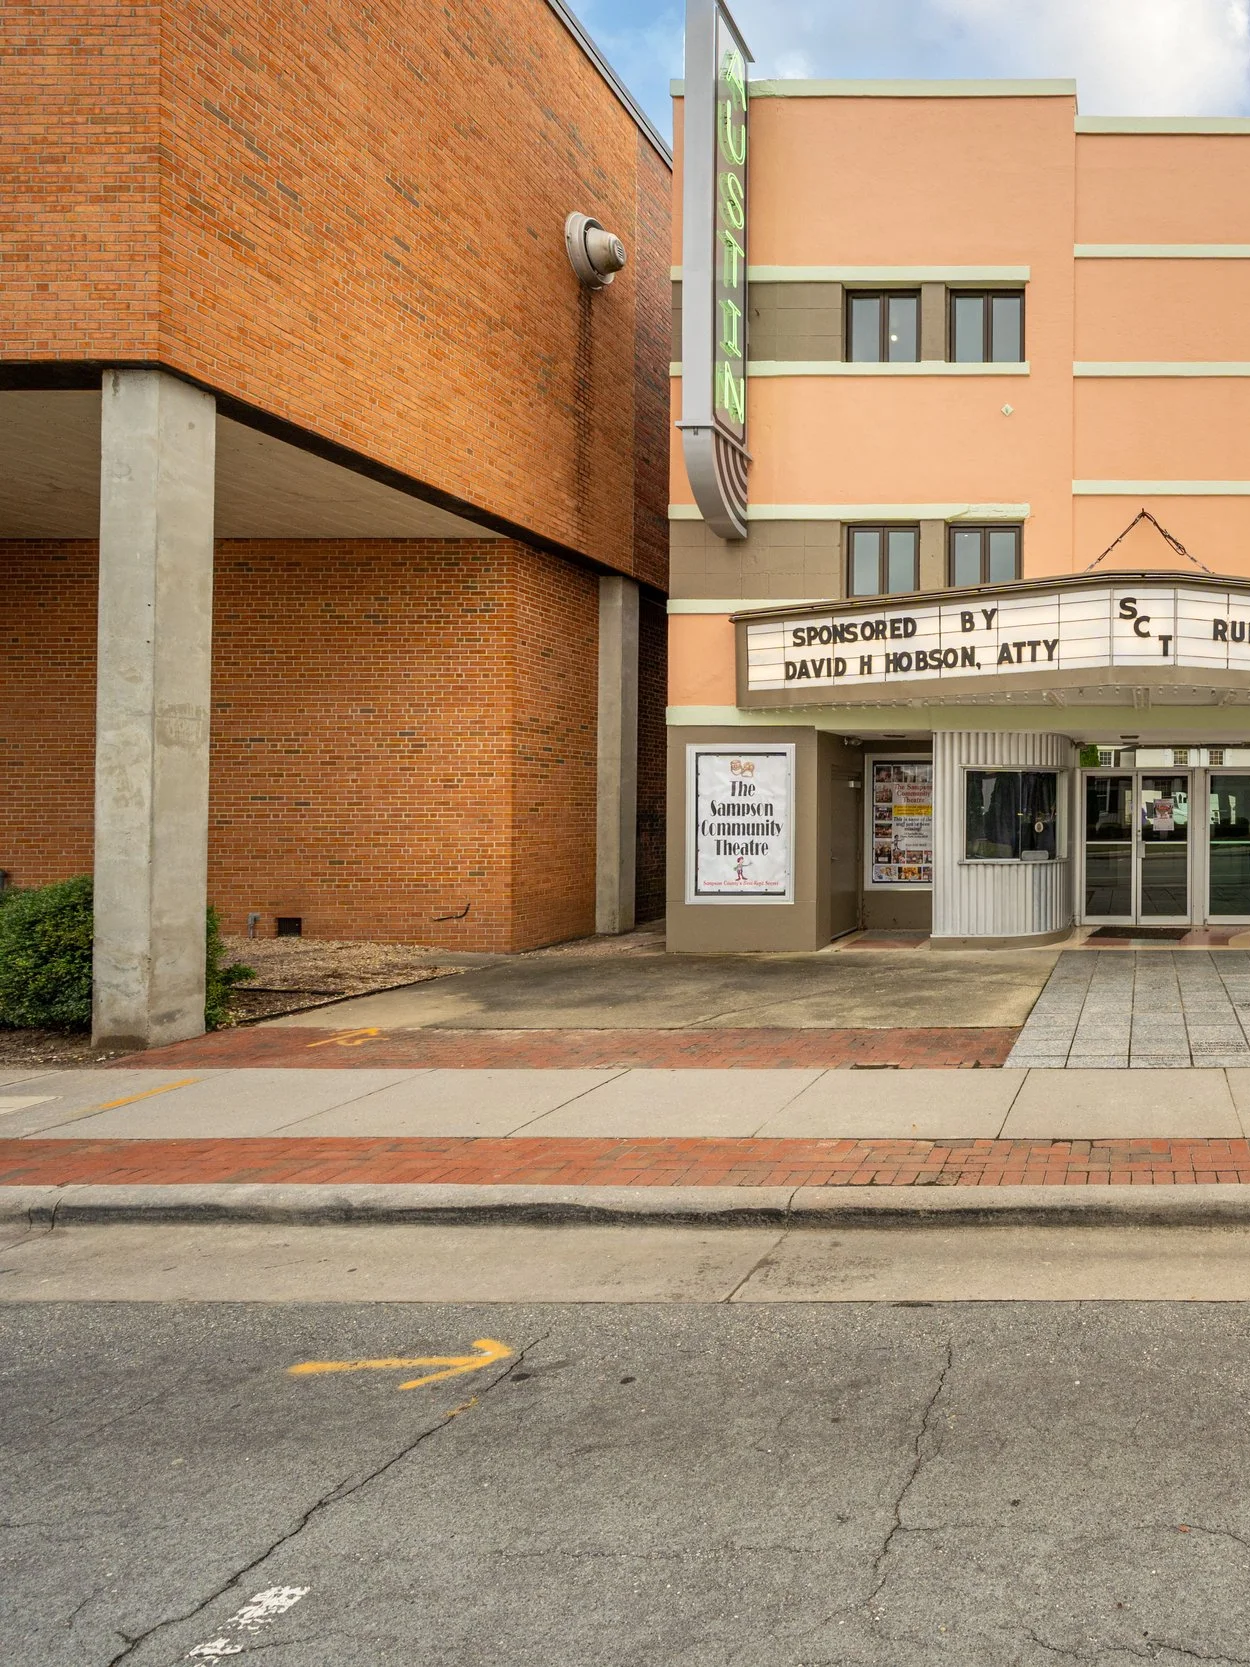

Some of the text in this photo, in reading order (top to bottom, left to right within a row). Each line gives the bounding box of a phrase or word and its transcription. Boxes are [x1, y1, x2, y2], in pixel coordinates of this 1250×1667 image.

[717, 49, 747, 425] AUSTIN
[792, 608, 998, 647] SPONSORED BY
[785, 639, 1059, 681] DAVID H HOBSON, ATTY
[729, 780, 756, 797] The
[710, 799, 774, 817] Sampson
[701, 819, 784, 837] Community
[714, 839, 769, 856] Theatre
